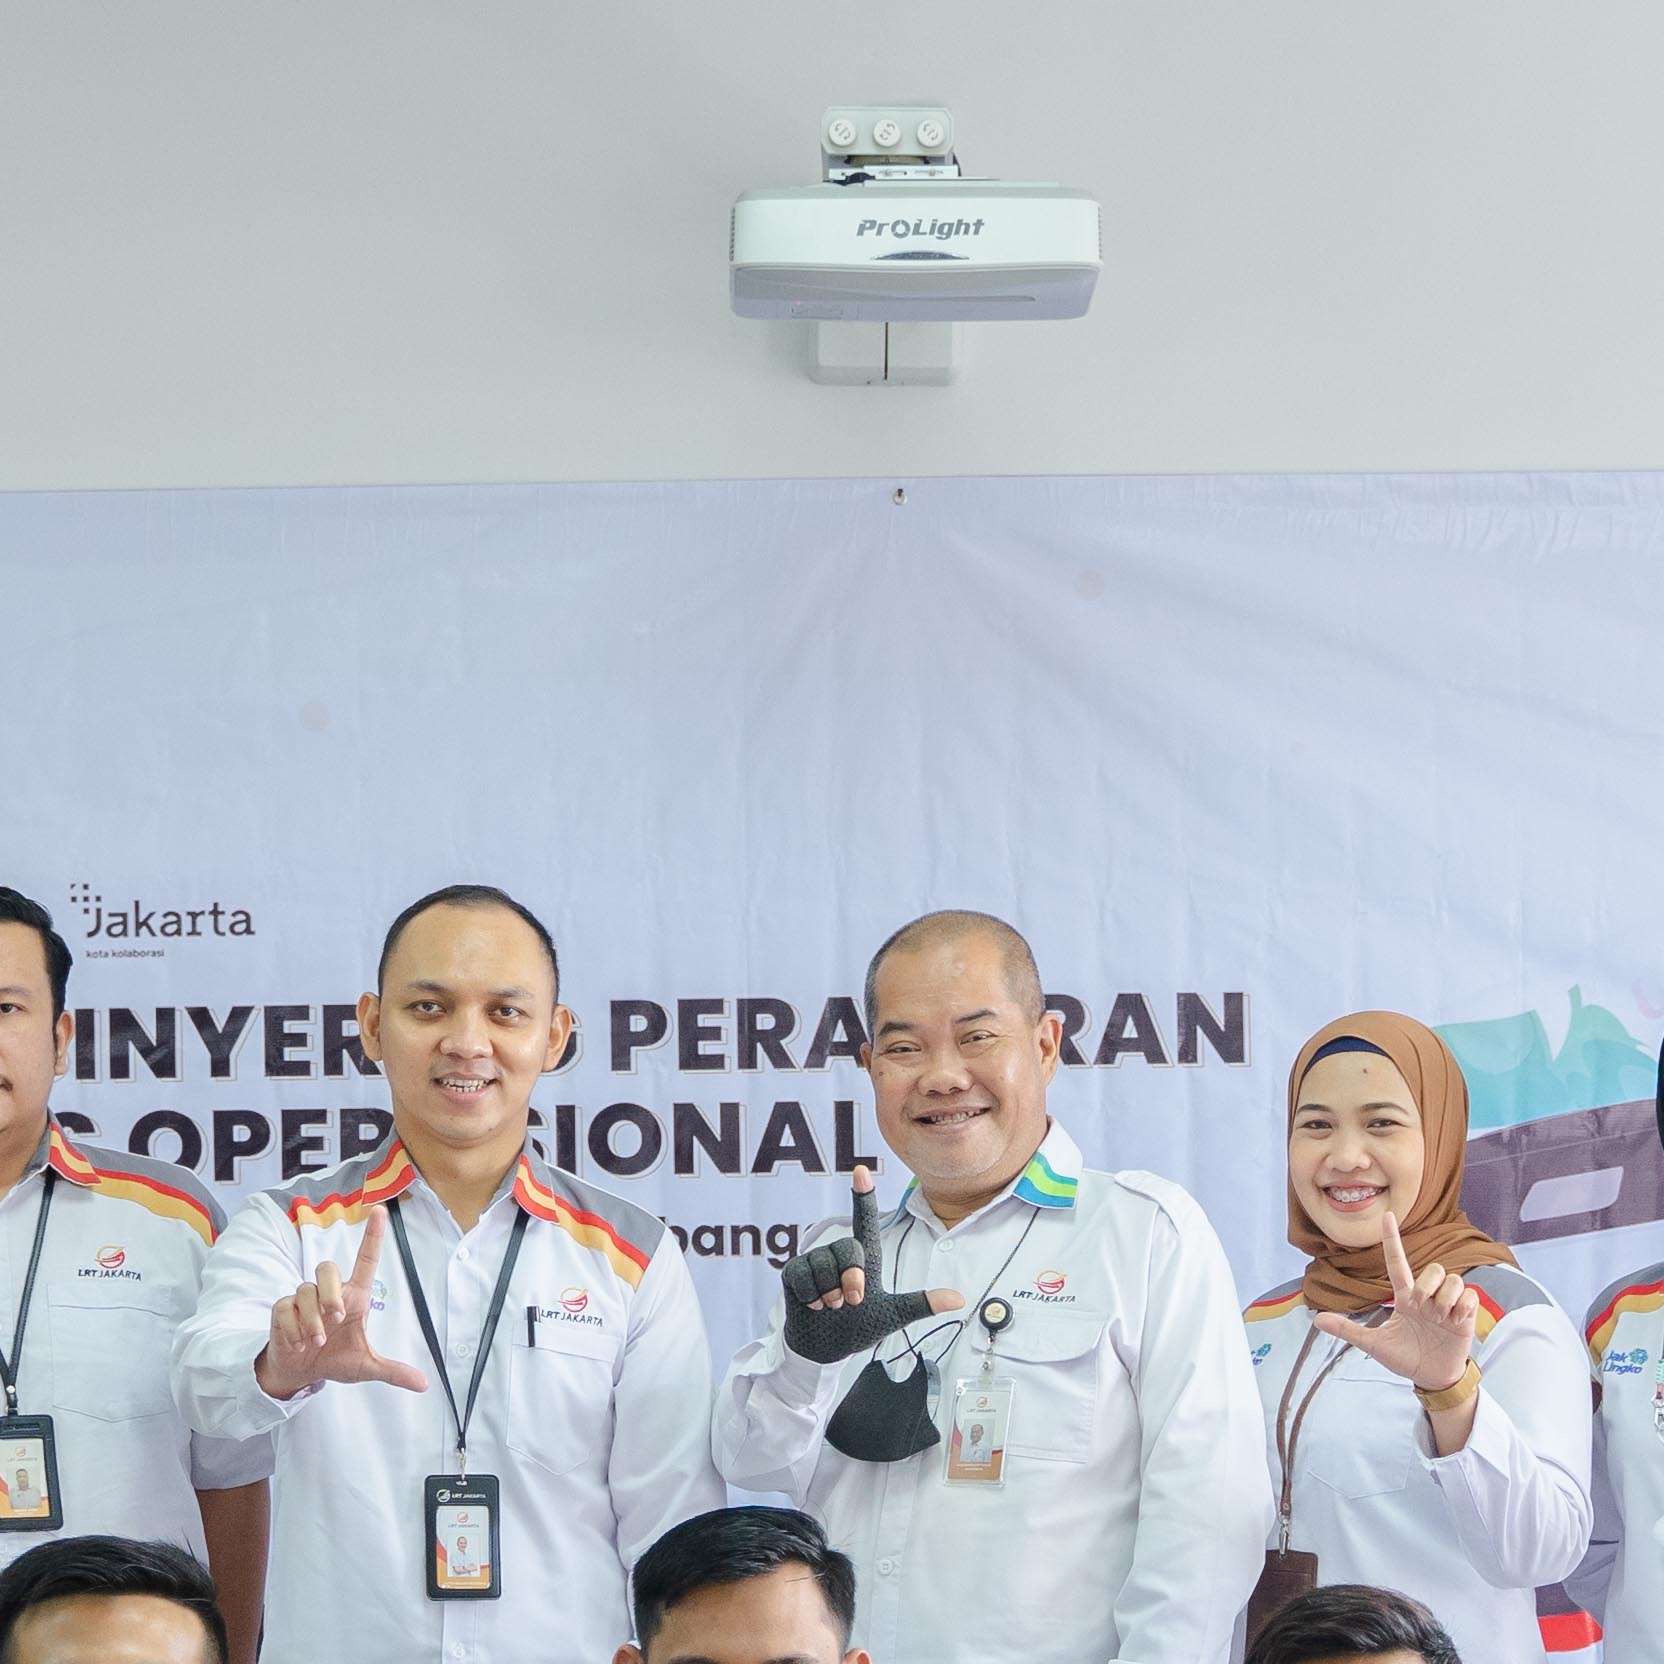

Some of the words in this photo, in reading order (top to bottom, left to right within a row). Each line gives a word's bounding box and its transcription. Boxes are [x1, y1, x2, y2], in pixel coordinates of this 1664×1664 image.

[86, 950, 109, 959] kota
[111, 948, 165, 959] kolaborasi
[610, 991, 1246, 1072] PERARAN
[77, 1268, 98, 1278] LRT
[98, 1269, 142, 1282] JAKARTA
[560, 1311, 604, 1328] JAKARTA
